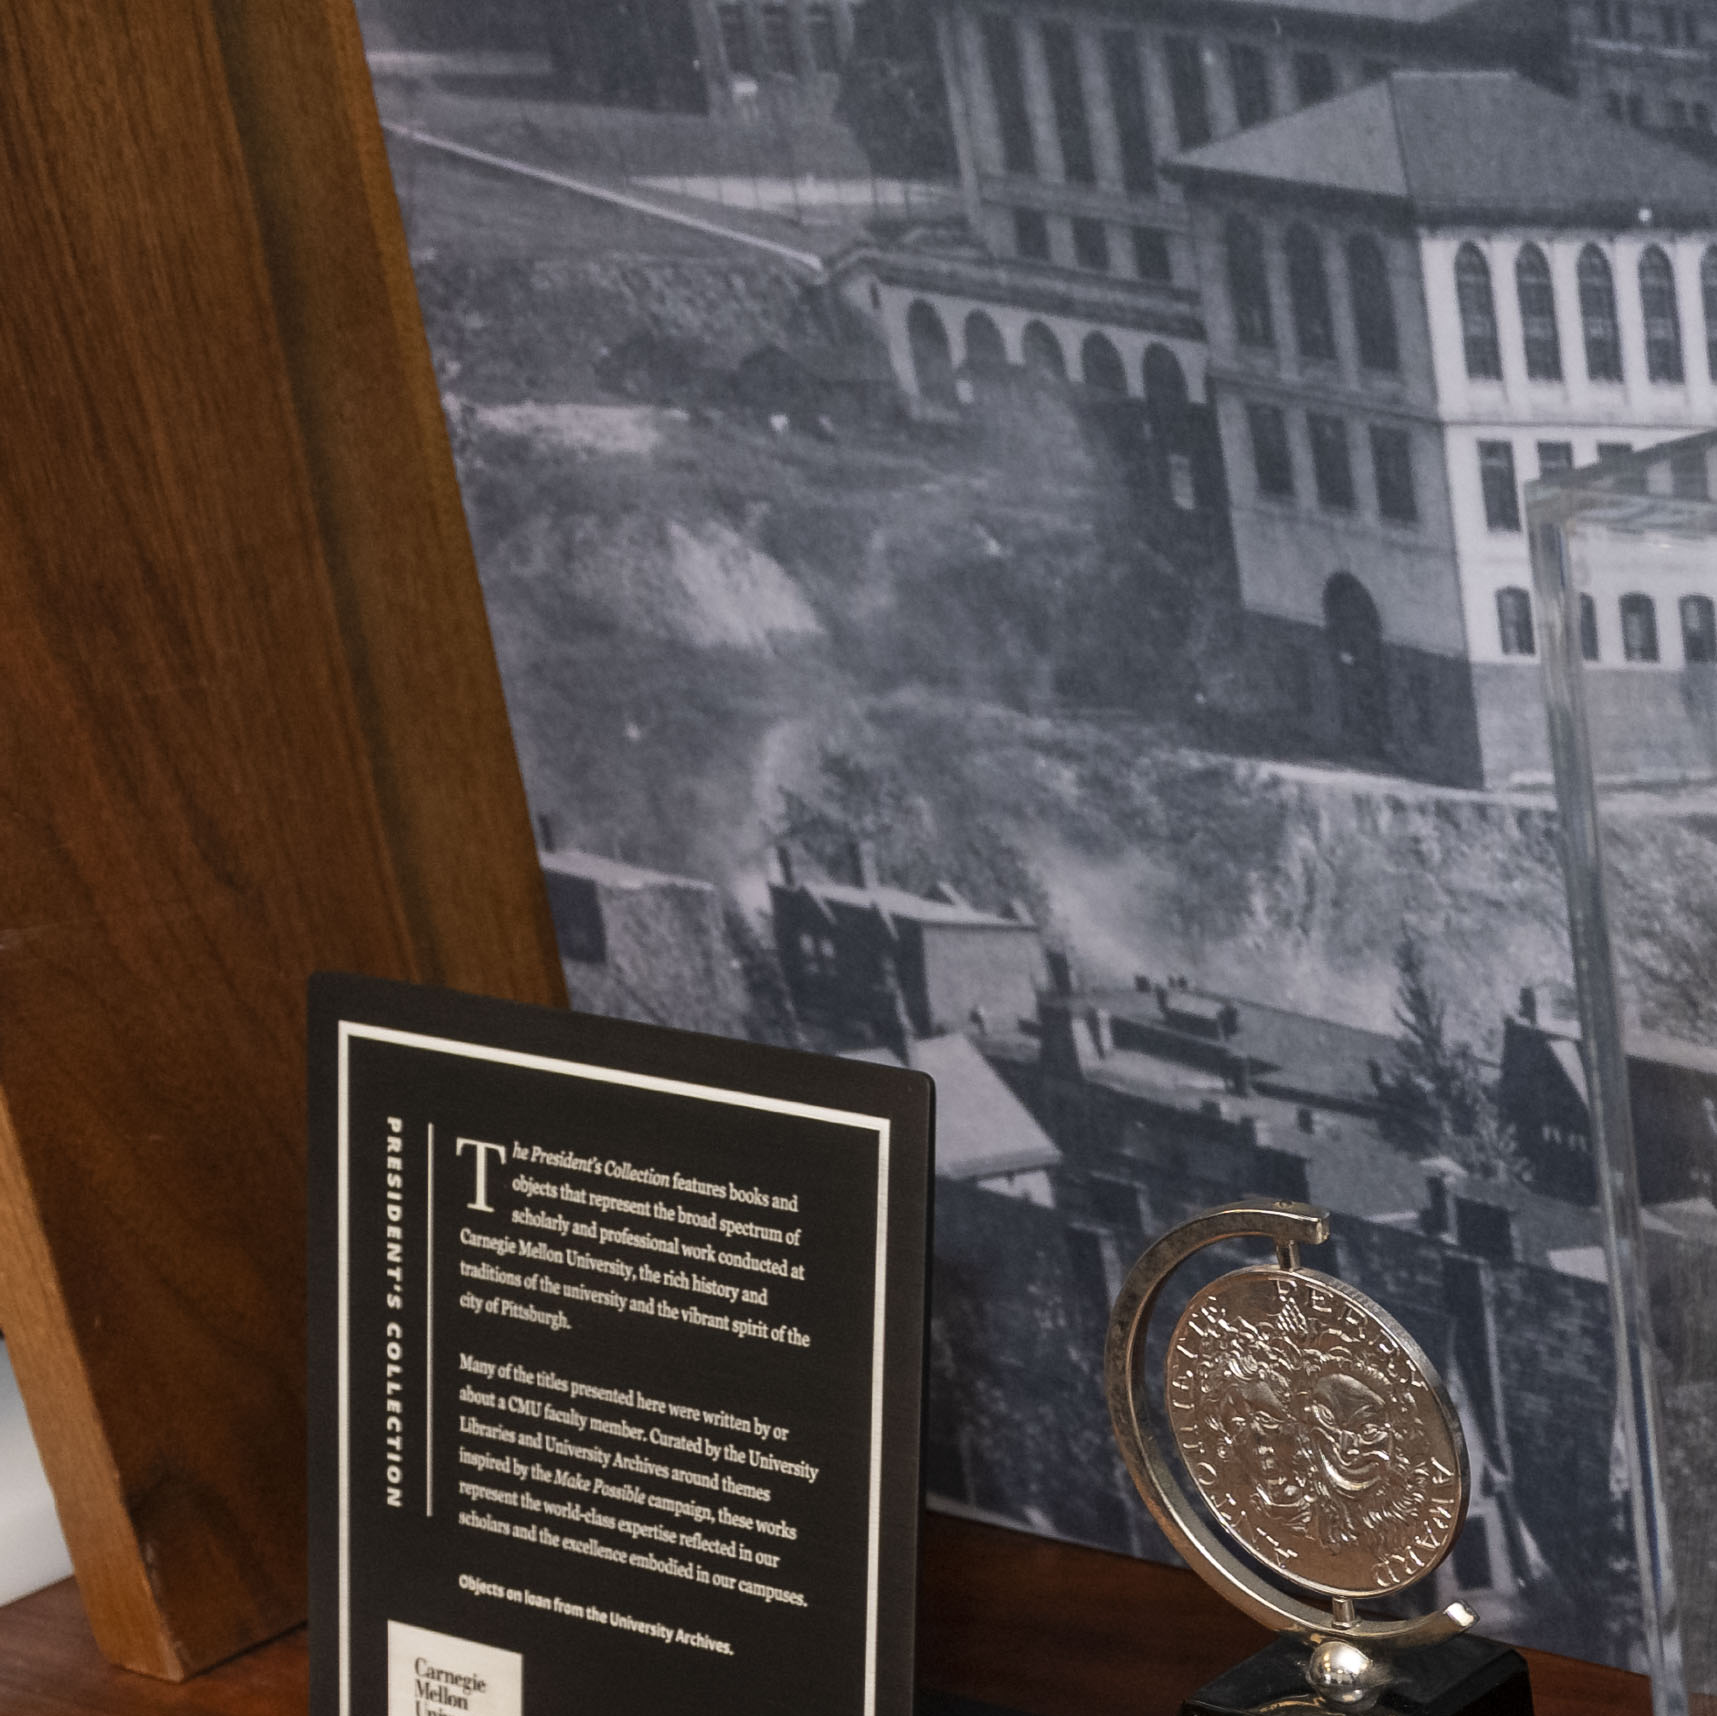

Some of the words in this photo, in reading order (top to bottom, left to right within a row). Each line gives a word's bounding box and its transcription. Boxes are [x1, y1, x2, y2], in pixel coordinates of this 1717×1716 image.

[385, 1115, 404, 1310] PRESIDENT'S
[511, 1173, 558, 1198] objects
[559, 1182, 586, 1204] that
[588, 1192, 651, 1217] represent
[652, 1201, 675, 1221] the
[677, 1205, 716, 1229] broad
[718, 1218, 782, 1242] spectrum
[784, 1228, 801, 1246] of
[530, 1145, 602, 1174] President's
[603, 1159, 670, 1187] Collection
[672, 1171, 726, 1198] features
[728, 1181, 769, 1207] books
[771, 1194, 798, 1212] and
[460, 1227, 516, 1256] Carnegie
[518, 1238, 564, 1263] Mellon
[565, 1248, 636, 1281] University,
[638, 1263, 661, 1283] the
[662, 1269, 690, 1290] rich
[691, 1273, 739, 1303] history
[741, 1287, 768, 1305] and
[511, 1206, 570, 1236] scholarly
[571, 1220, 597, 1238] and
[599, 1227, 679, 1254] professional
[680, 1243, 716, 1262] work
[717, 1251, 788, 1276] conducted
[790, 1264, 804, 1280] at
[459, 1291, 483, 1313] city
[484, 1296, 499, 1313] of
[500, 1299, 571, 1330] Pittsburgh.
[460, 1260, 521, 1287] traditions
[523, 1273, 538, 1290] of
[539, 1275, 560, 1295] the
[562, 1283, 628, 1312] university
[628, 1296, 654, 1315] and
[656, 1299, 679, 1320] the
[680, 1306, 729, 1330] vibrant
[731, 1318, 768, 1338] spirit
[770, 1324, 787, 1342] of
[786, 1326, 810, 1347] the
[385, 1321, 404, 1508] COLLECTION
[459, 1352, 496, 1379] Many
[497, 1362, 512, 1379] of
[513, 1364, 534, 1384] the
[536, 1370, 568, 1392] titles
[570, 1381, 634, 1406] presented
[636, 1390, 666, 1413] here
[668, 1403, 700, 1421] were
[702, 1410, 751, 1432] written
[753, 1416, 771, 1440] by
[772, 1426, 789, 1440] or
[459, 1384, 495, 1407] about
[497, 1396, 506, 1410] a
[507, 1395, 542, 1417] CMU
[544, 1402, 588, 1431] faculty
[590, 1417, 647, 1441] member.
[648, 1427, 702, 1454] Curated
[704, 1437, 722, 1461] by
[723, 1443, 746, 1463] the
[748, 1448, 818, 1483] University
[458, 1446, 510, 1473] inspired
[512, 1457, 528, 1480] by
[530, 1462, 552, 1482] the
[553, 1468, 591, 1491] Make
[592, 1477, 646, 1504] Possible
[647, 1494, 715, 1523] campaign,
[717, 1506, 754, 1530] these
[755, 1519, 796, 1540] works
[459, 1415, 516, 1443] Libraries
[517, 1431, 542, 1449] and
[544, 1434, 611, 1468] University
[612, 1451, 669, 1478] Archives
[670, 1468, 719, 1490] around
[721, 1475, 770, 1501] themes
[458, 1481, 518, 1506] represent
[520, 1491, 541, 1511] the
[542, 1500, 616, 1529] world-class
[617, 1519, 677, 1543] expertise
[678, 1531, 736, 1557] reflected
[738, 1543, 752, 1562] in
[754, 1551, 780, 1567] our
[458, 1510, 510, 1535] scholars
[511, 1524, 536, 1541] and
[538, 1527, 560, 1547] the
[561, 1537, 627, 1563] excellence
[628, 1552, 694, 1579] embodied
[696, 1564, 710, 1583] in
[712, 1573, 736, 1589] our
[737, 1580, 807, 1607] campuses.
[1372, 1456, 1457, 1588] AWARD
[458, 1573, 504, 1598] Objects
[506, 1588, 522, 1602] on
[524, 1589, 552, 1609] loan
[553, 1596, 584, 1618] from
[585, 1605, 608, 1623] the
[609, 1611, 674, 1643] University
[674, 1628, 733, 1655] Archives.
[415, 1657, 487, 1695] Carnegie
[415, 1678, 469, 1711] Mellon
